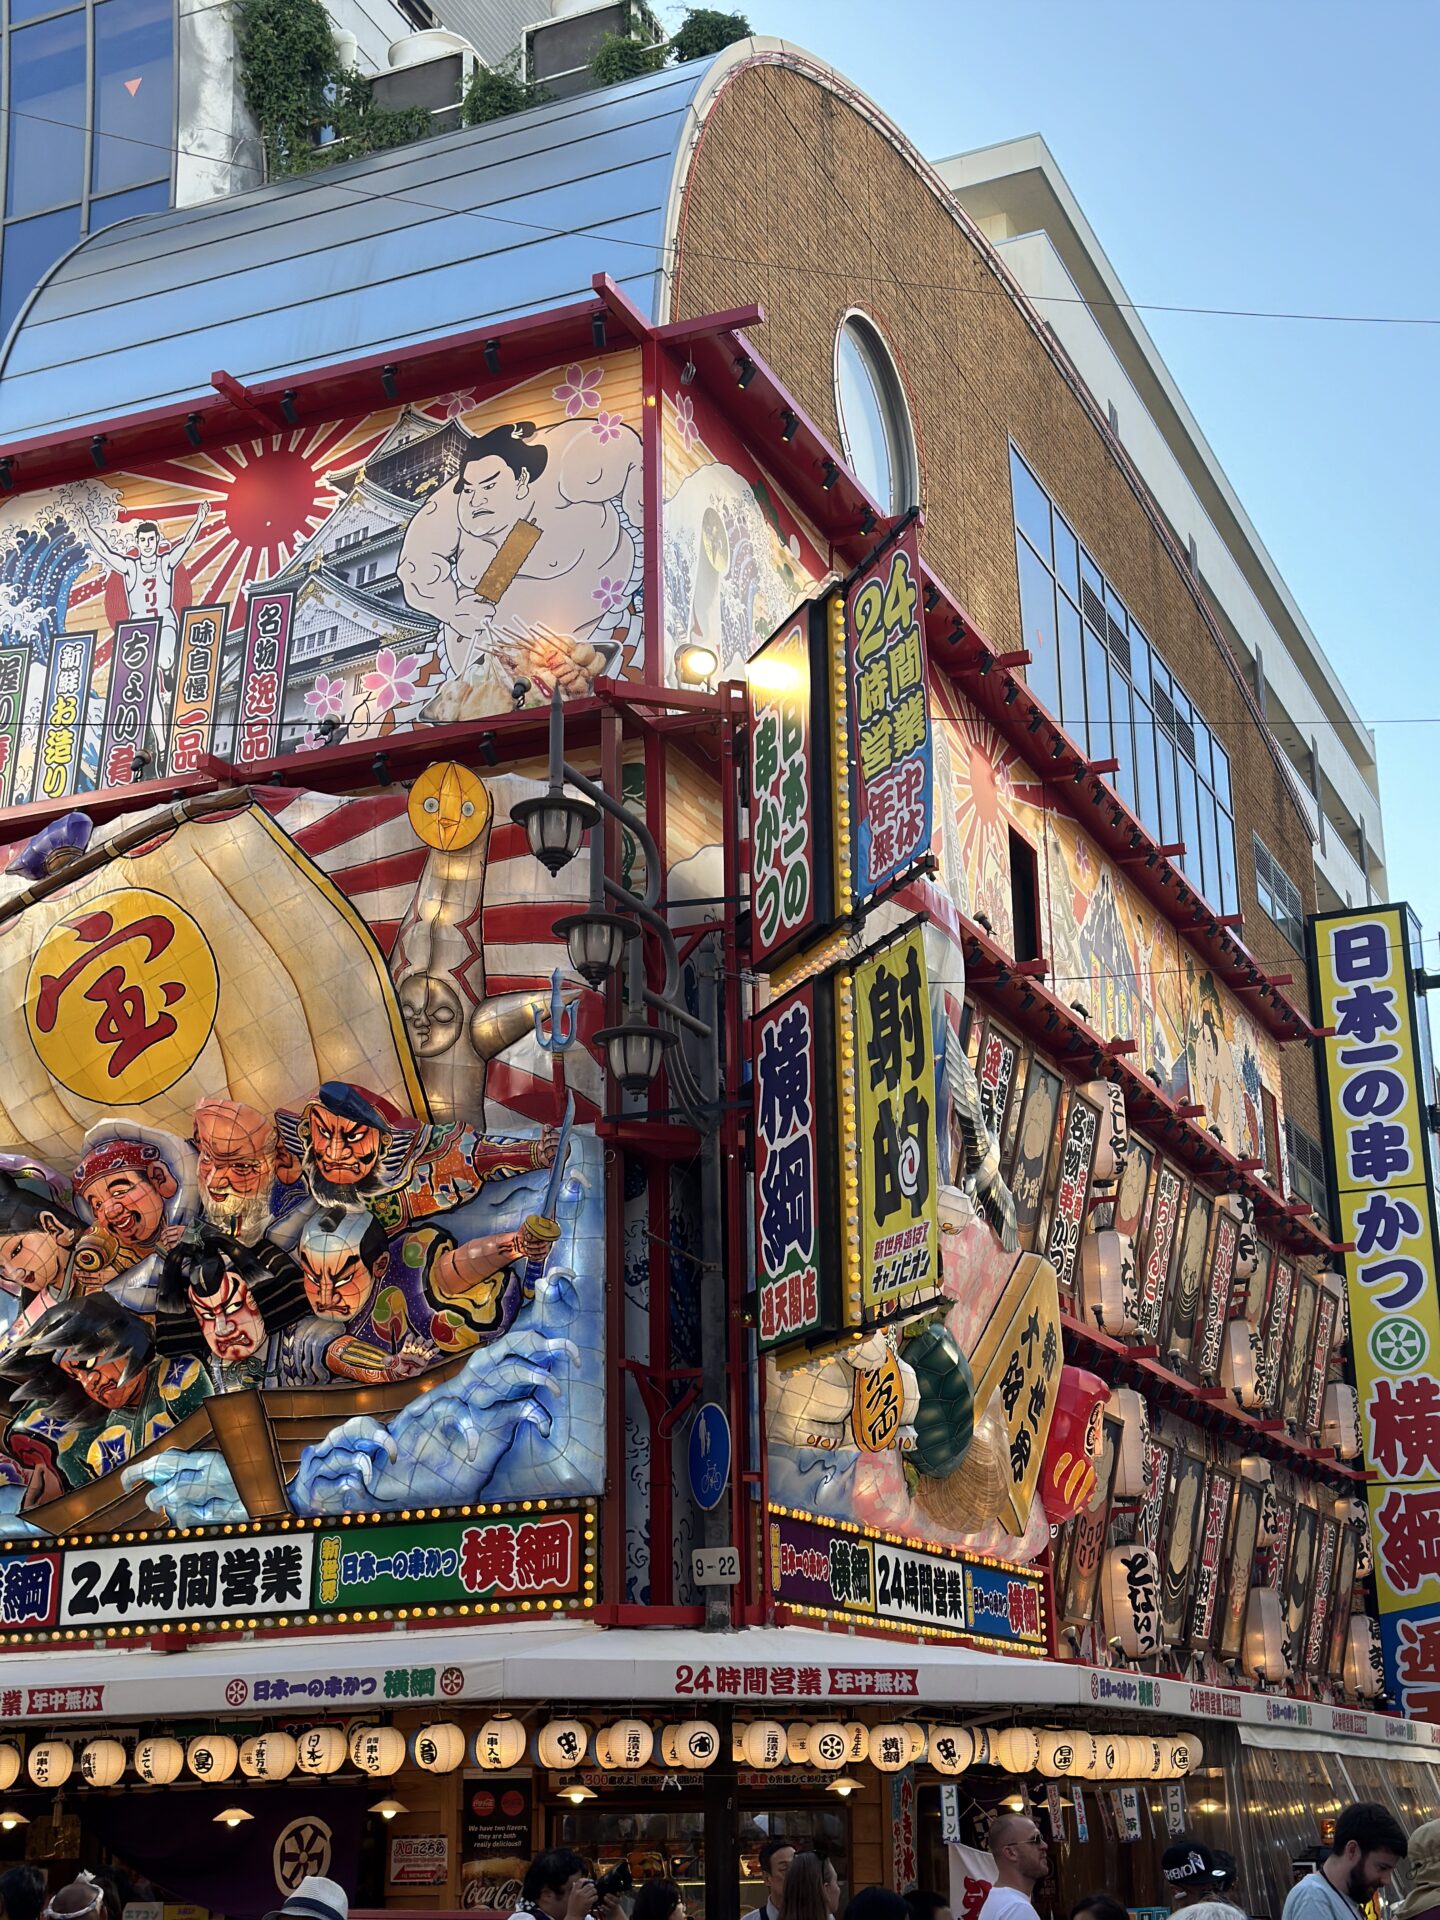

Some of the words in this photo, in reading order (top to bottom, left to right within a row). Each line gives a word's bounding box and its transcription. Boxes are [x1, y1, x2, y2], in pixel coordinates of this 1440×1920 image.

[855, 557, 915, 664] 24
[172, 620, 215, 772] 味自慢一品
[240, 603, 281, 762] 名物逸品
[860, 627, 922, 720] 時間
[43, 644, 84, 798] 新鮮お造り
[107, 631, 149, 785] ちょい肴
[861, 690, 925, 778] 営業
[781, 700, 808, 926] 日本一の
[869, 759, 922, 830] 年中
[754, 712, 780, 946] 串かつ
[869, 804, 922, 880] 無休
[868, 946, 930, 1227] 射的
[1333, 924, 1424, 1309] 日本一の串かつ
[758, 1001, 814, 1277] 横綱
[1050, 1103, 1087, 1277] 名物串かつ
[760, 1266, 817, 1340] 通天閣店
[872, 1249, 930, 1293] チャンピオン
[0, 1559, 53, 1624] 綱
[68, 1545, 302, 1616] 24時間営業
[320, 1536, 341, 1604] 新世界
[342, 1548, 457, 1584] 日本一の串かつ
[459, 1521, 572, 1592] 横綱
[780, 1543, 829, 1581] 日本一の串かつ
[830, 1539, 871, 1605] 横綱
[878, 1555, 963, 1620] 24時間営業
[1008, 1580, 1038, 1635] 横綱
[32, 1689, 99, 1712] 年中無休
[253, 1676, 377, 1701] 日本一の串かつ
[384, 1668, 436, 1698] 横綱
[675, 1665, 822, 1695] 24時間営業
[833, 1671, 914, 1694] 年中無休
[36, 1758, 49, 1783] 串かつ
[256, 1739, 268, 1775] 千客万来
[307, 1734, 324, 1768] 日本一
[366, 1745, 379, 1771] 串かつ
[487, 1732, 501, 1765] 一串入魂
[627, 1730, 640, 1757] 二度漬け
[766, 1730, 778, 1757] 二度漬け
[882, 1737, 900, 1763] 横綱
[478, 1833, 491, 1841] they
[901, 1776, 916, 1882] かき氷
[945, 1788, 956, 1834] メロン
[1170, 1788, 1182, 1828] メロン
[394, 1840, 446, 1856] 入口はこちら
